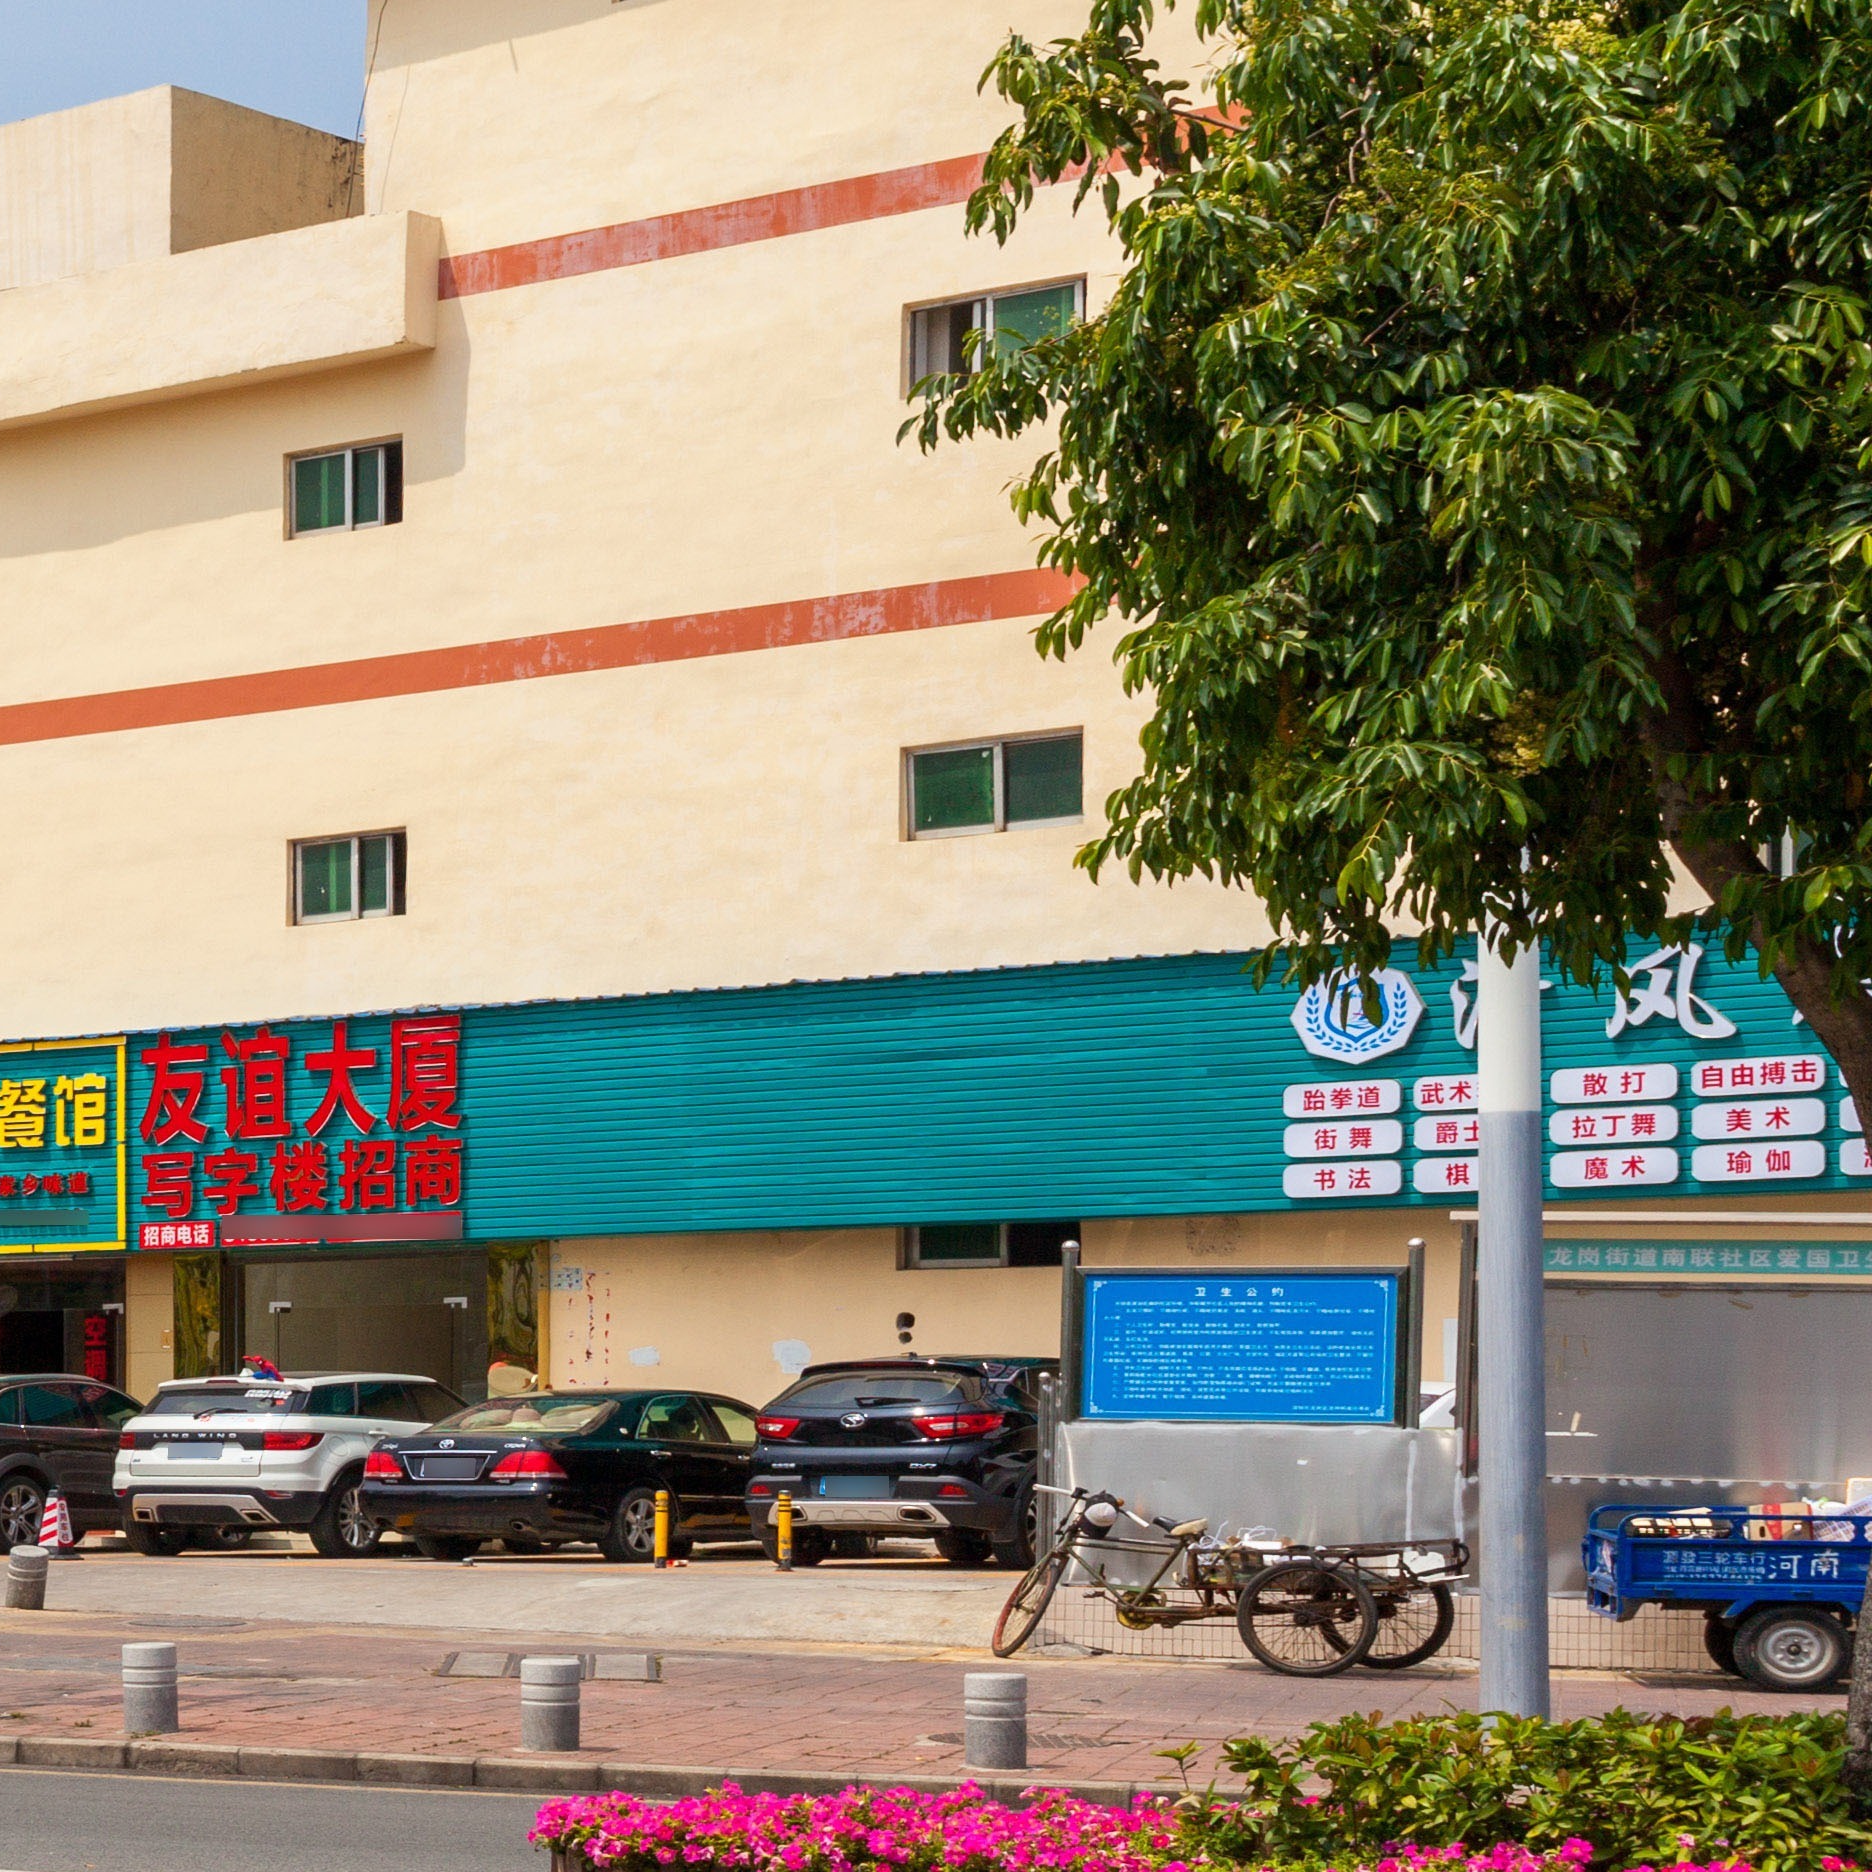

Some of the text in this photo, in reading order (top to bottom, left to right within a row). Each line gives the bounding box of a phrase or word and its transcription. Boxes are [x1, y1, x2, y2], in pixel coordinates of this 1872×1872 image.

[139, 1015, 462, 1146] 友谊大厦
[1583, 1072, 1646, 1096] 散打
[1701, 1060, 1818, 1089] 自由搏击
[1302, 1085, 1381, 1110] 跆拳道
[1419, 1080, 1478, 1105] 武术
[1572, 1113, 1656, 1138] 拉丁舞
[1726, 1106, 1790, 1131] 美术
[1314, 1126, 1373, 1151] 街舞
[1584, 1155, 1646, 1180] 魔术
[1727, 1149, 1791, 1174] 瑜伽
[140, 1134, 462, 1218] 写字楼招商
[1314, 1167, 1371, 1191] 书法
[143, 1224, 209, 1246] 招商电话
[1195, 1286, 1284, 1297] 卫生公约
[1768, 1549, 1840, 1579] 河南
